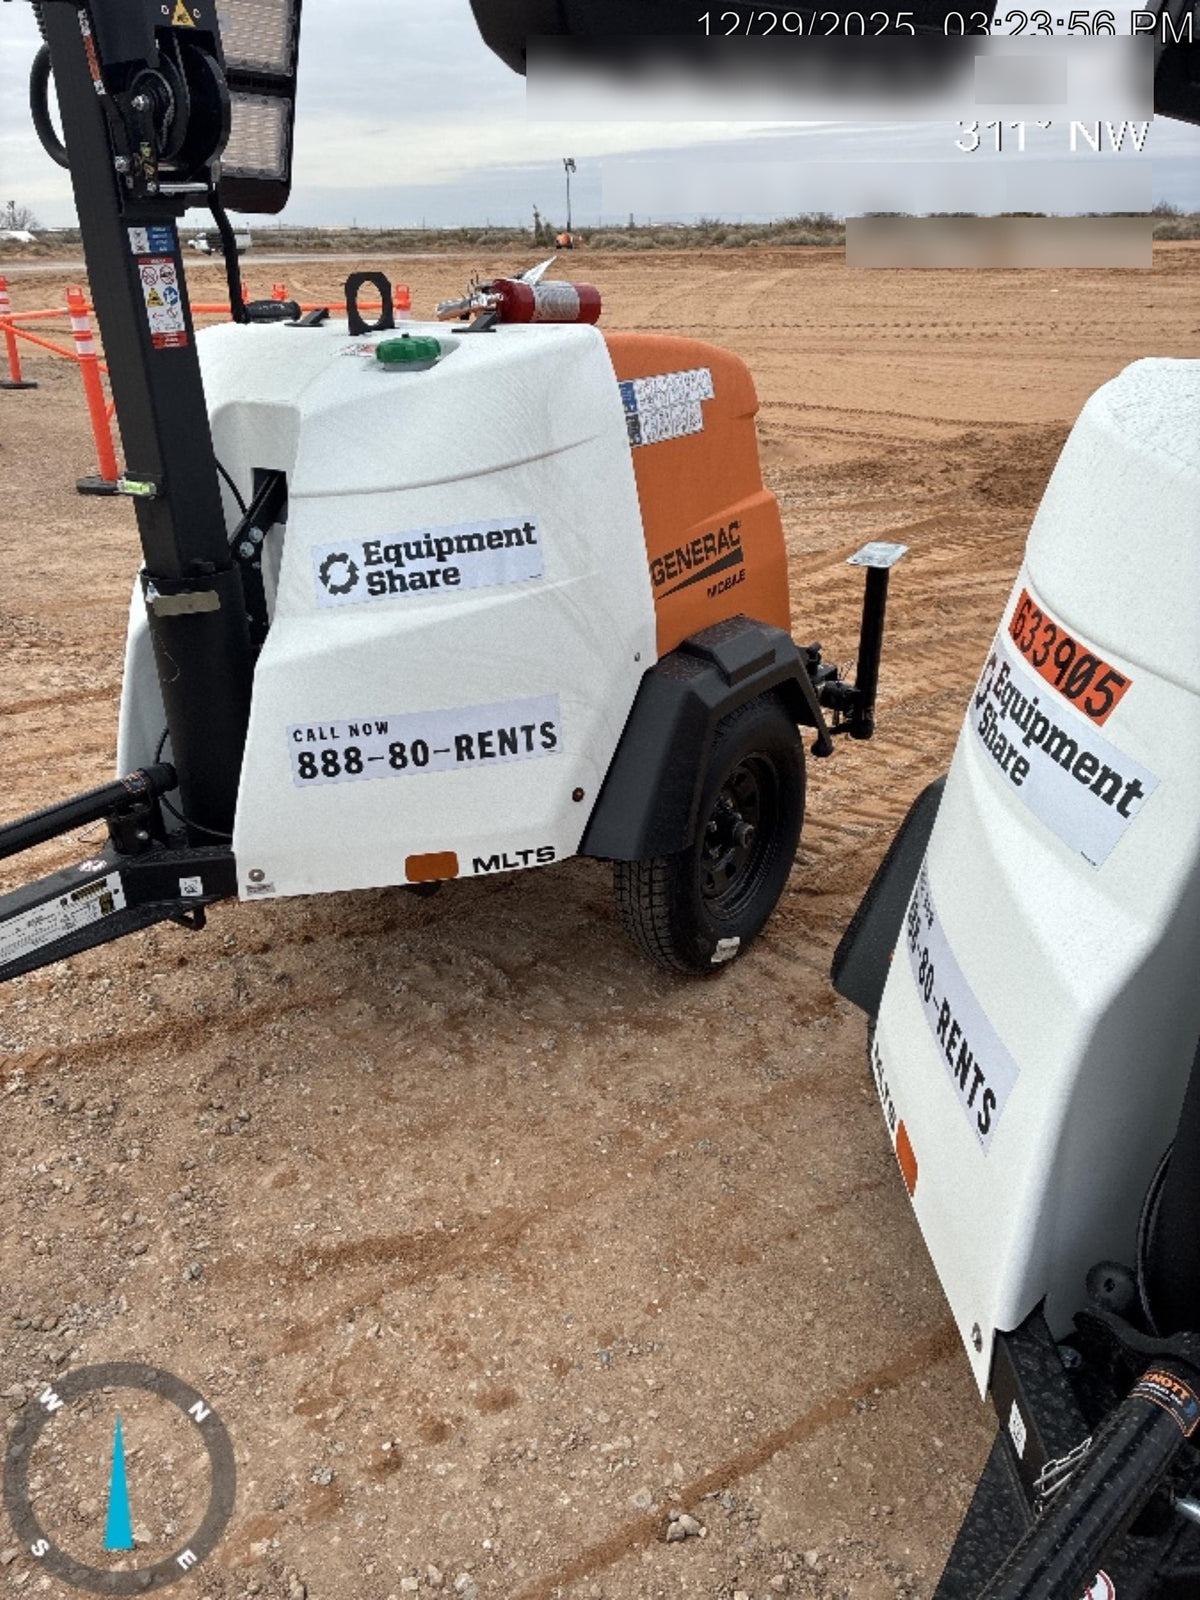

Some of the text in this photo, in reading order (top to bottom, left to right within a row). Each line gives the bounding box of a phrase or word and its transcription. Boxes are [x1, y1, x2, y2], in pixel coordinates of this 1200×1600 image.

[362, 521, 537, 567] Equipment
[650, 520, 740, 587] GENERAC
[366, 565, 461, 596] Share
[1013, 598, 1126, 717] 633905
[293, 721, 390, 743] CALL NOW
[297, 721, 558, 779] 888-80-RENTS
[977, 706, 1031, 787] Share
[993, 661, 1145, 819] Equipment
[472, 845, 556, 874] MLTS
